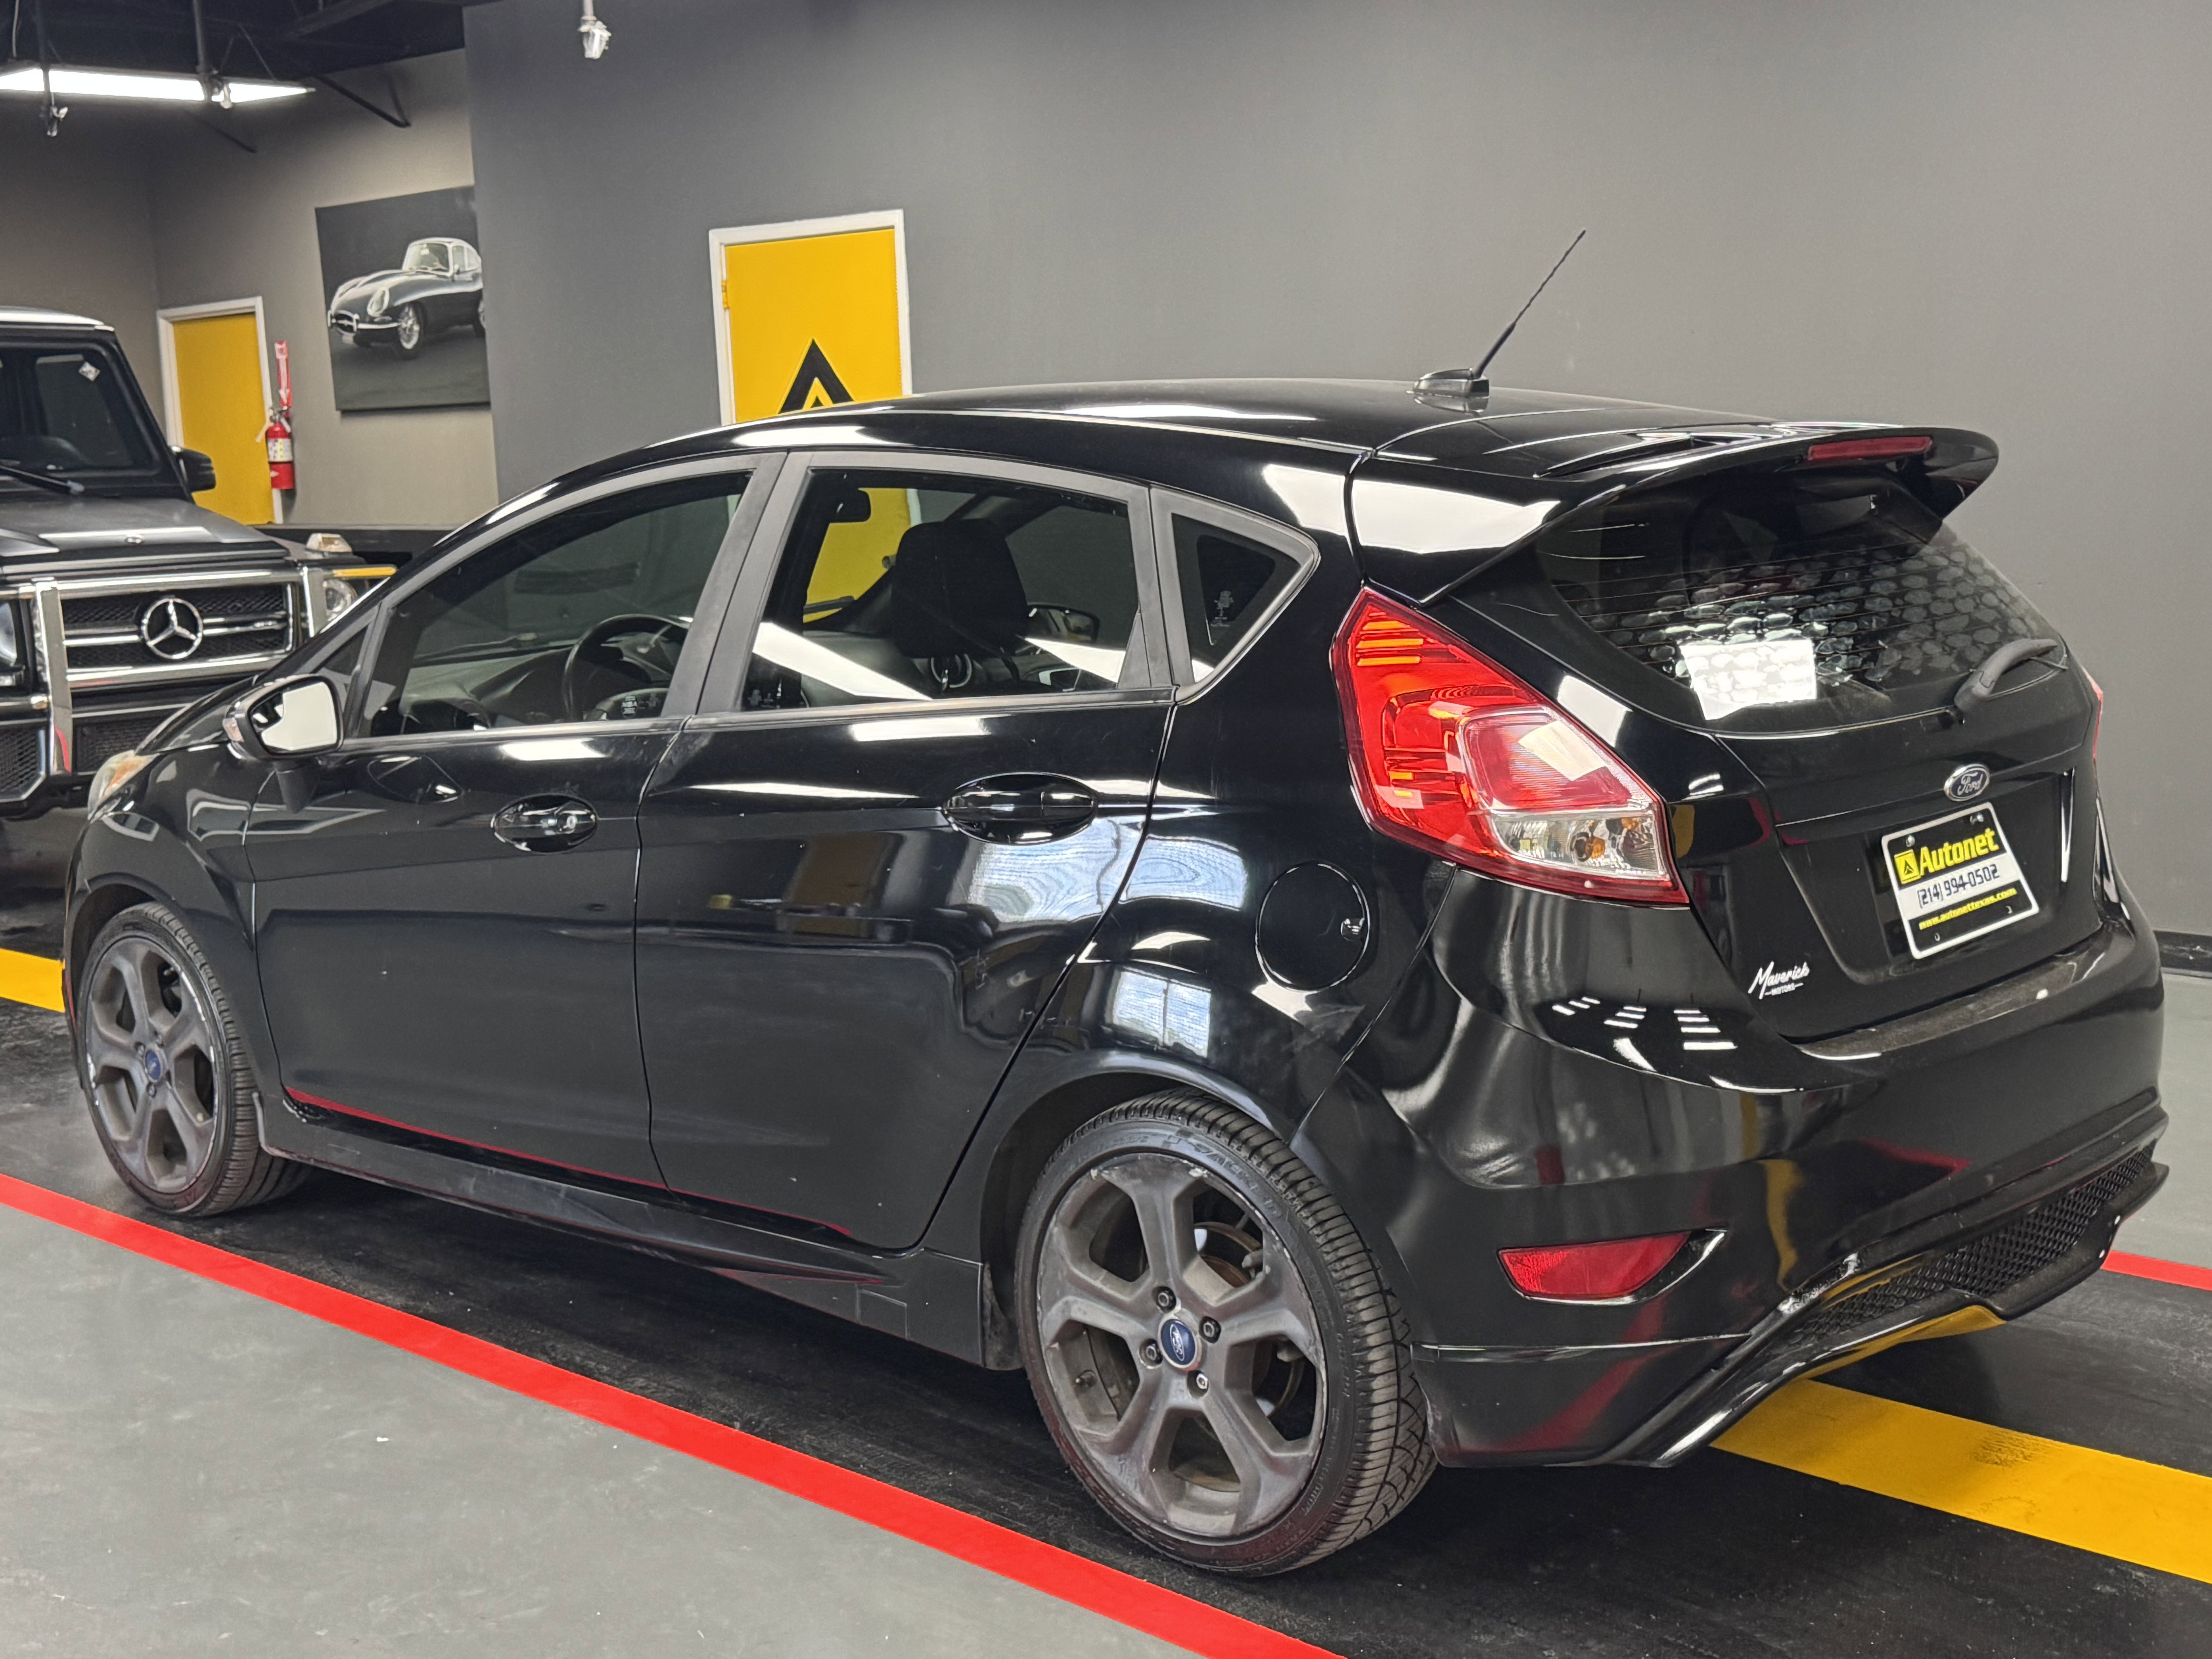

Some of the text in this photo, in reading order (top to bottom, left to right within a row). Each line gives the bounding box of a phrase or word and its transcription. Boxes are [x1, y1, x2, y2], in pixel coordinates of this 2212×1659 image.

[1957, 772, 1983, 796] Ford
[1920, 827, 1999, 877] Autonet
[1917, 864, 2000, 909] (214) 994-0502
[1919, 887, 2018, 930] www.autonettexas.com
[1748, 960, 1810, 1000] Maverick
